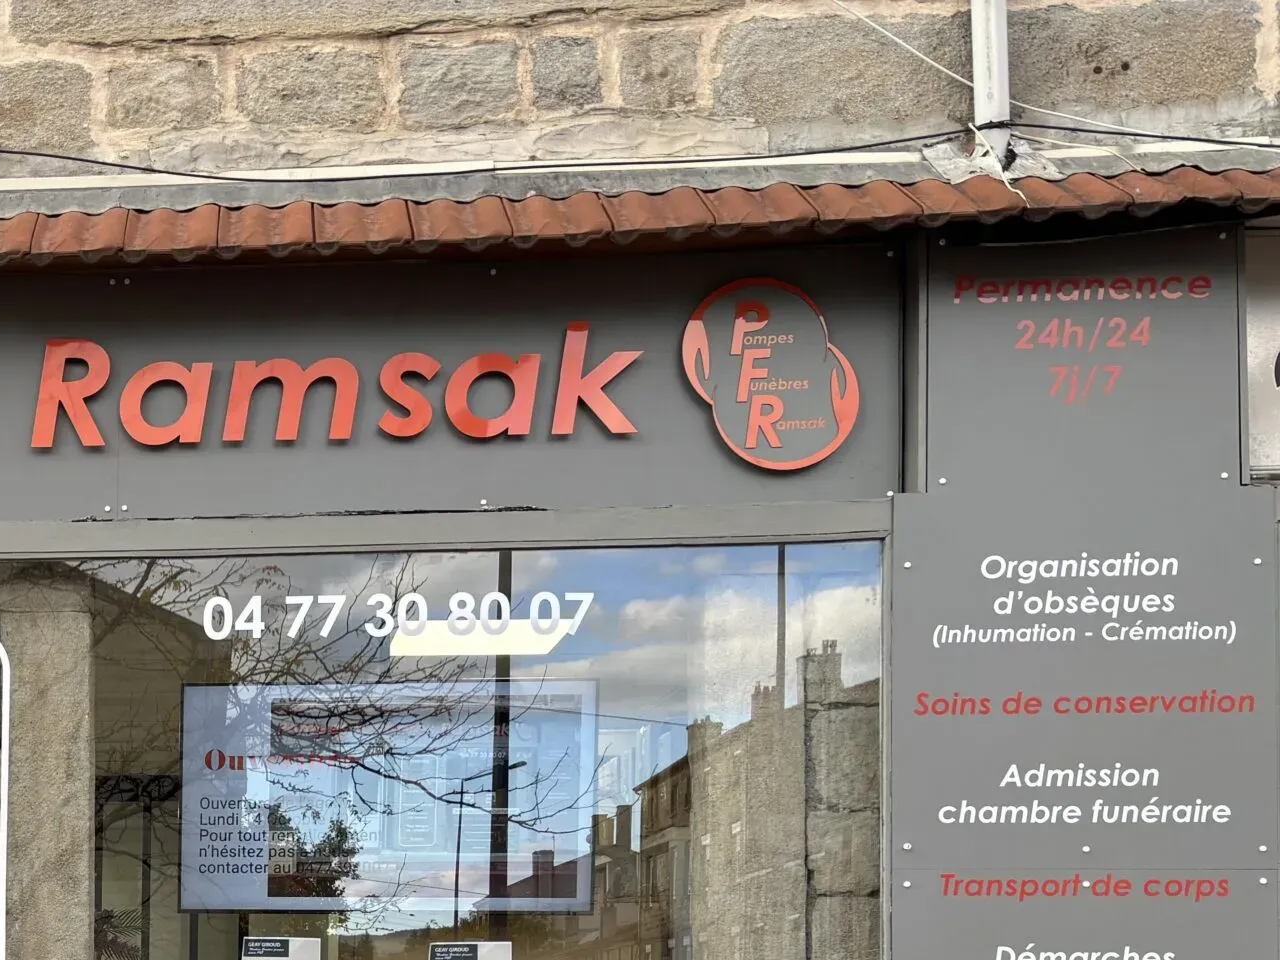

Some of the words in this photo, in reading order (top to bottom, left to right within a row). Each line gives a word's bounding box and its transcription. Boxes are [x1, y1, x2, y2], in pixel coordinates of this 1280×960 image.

[953, 274, 1213, 305] Permanence
[1014, 316, 1152, 353] 24h/24
[31, 322, 644, 449] Ramsak
[1047, 365, 1123, 405] 7j/7
[980, 551, 1179, 584] Organisation
[202, 595, 266, 640] 04
[284, 594, 347, 639] 77
[363, 592, 429, 638] 30
[446, 591, 512, 637] 80
[529, 591, 595, 636] 07
[993, 587, 1176, 618] d'obsèques
[932, 624, 1076, 648] (Inhumation
[1101, 620, 1237, 645] Crémation)
[913, 692, 991, 716] Soins
[1002, 692, 1042, 715] de
[1053, 689, 1255, 715] conservation
[999, 762, 1160, 788] Admission
[199, 812, 240, 827] Lundi
[937, 800, 1082, 824] chambre
[1091, 796, 1232, 824] funéraire
[199, 828, 234, 842] Pour
[238, 829, 267, 842] tout
[199, 844, 264, 858] n'hésitez
[268, 847, 295, 861] pas
[198, 862, 269, 874] contacter
[273, 864, 291, 875] au
[939, 873, 1082, 902] Transport
[1090, 873, 1132, 898] de
[1143, 877, 1230, 903] corps
